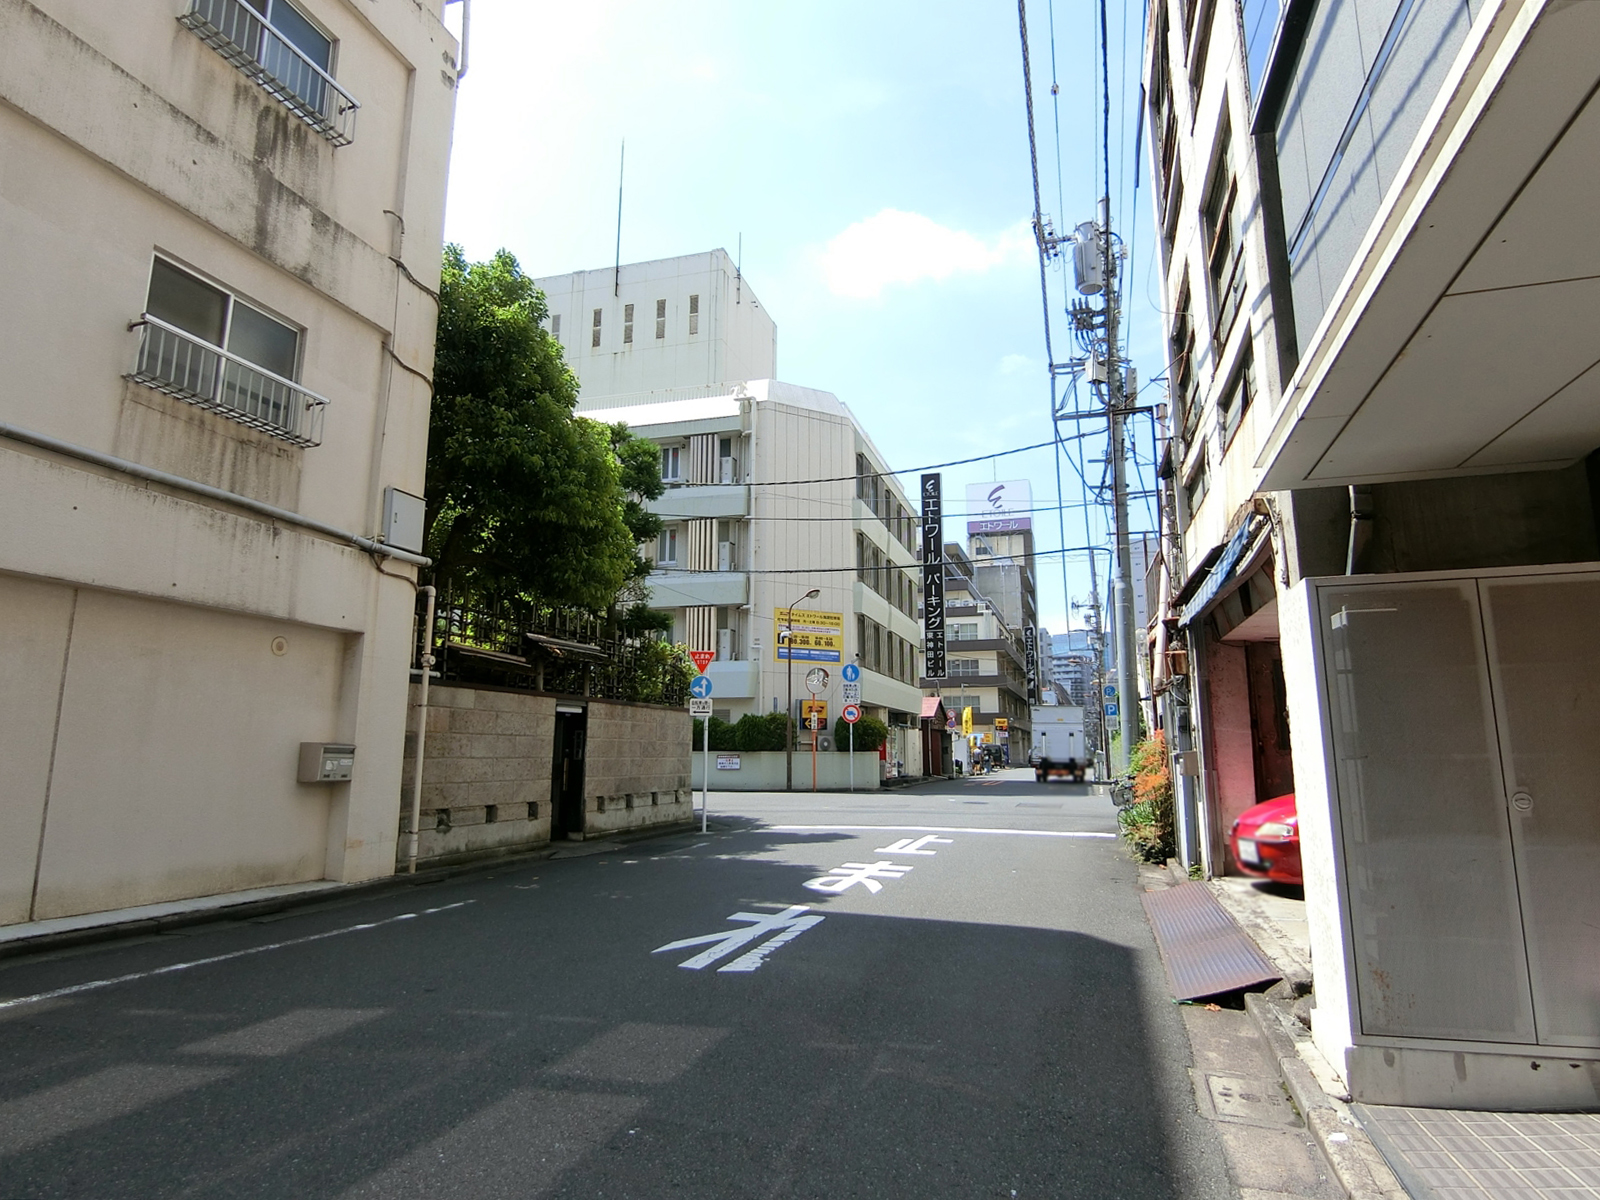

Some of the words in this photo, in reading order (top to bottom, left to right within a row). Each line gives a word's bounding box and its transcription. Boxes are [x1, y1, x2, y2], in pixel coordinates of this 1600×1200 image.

[980, 520, 1019, 530] エトワール
[926, 572, 942, 629] パーキング
[926, 632, 935, 677] 東神田ビル
[936, 632, 945, 677] エトワール
[1107, 704, 1115, 715] P
[650, 834, 954, 973] 止まれ
